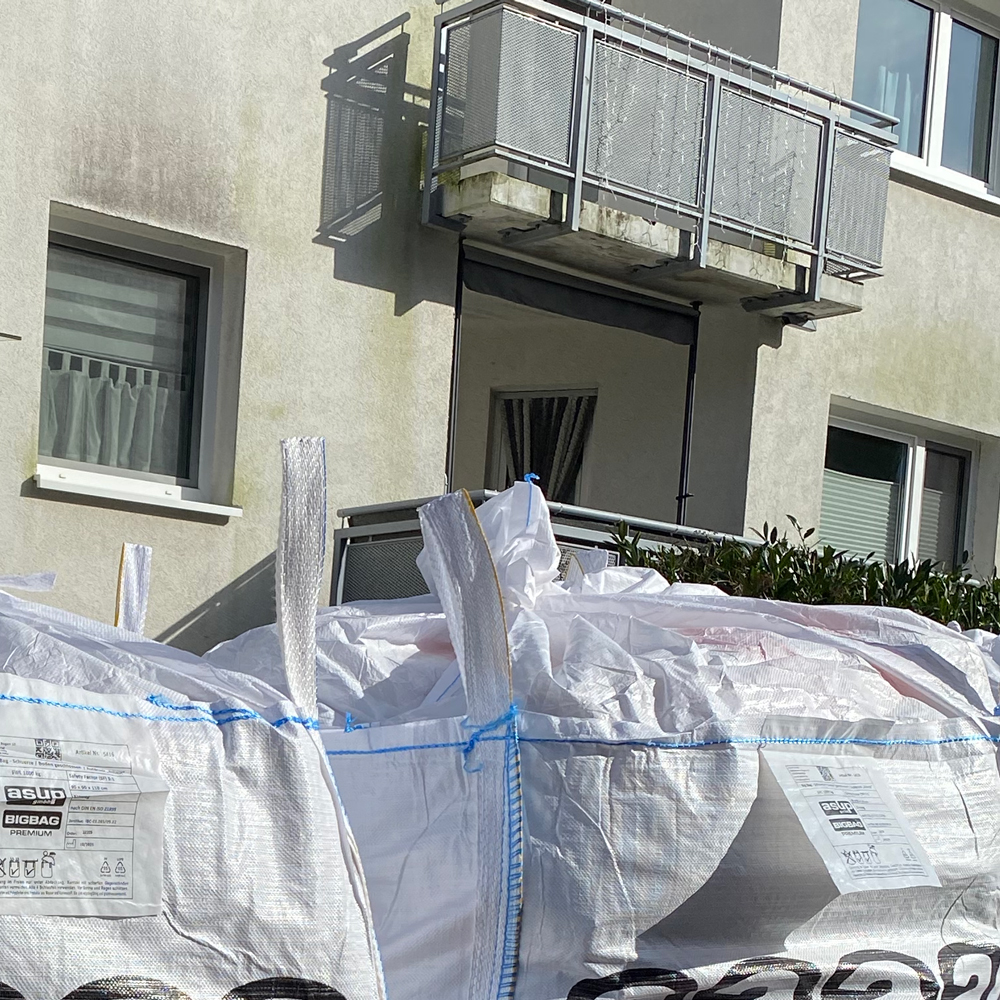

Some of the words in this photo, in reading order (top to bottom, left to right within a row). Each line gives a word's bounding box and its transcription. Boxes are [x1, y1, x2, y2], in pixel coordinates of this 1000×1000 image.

[7, 787, 66, 804] asup
[821, 801, 854, 813] asup
[4, 814, 60, 826] BIGBAG
[10, 829, 53, 838] PREMIUM
